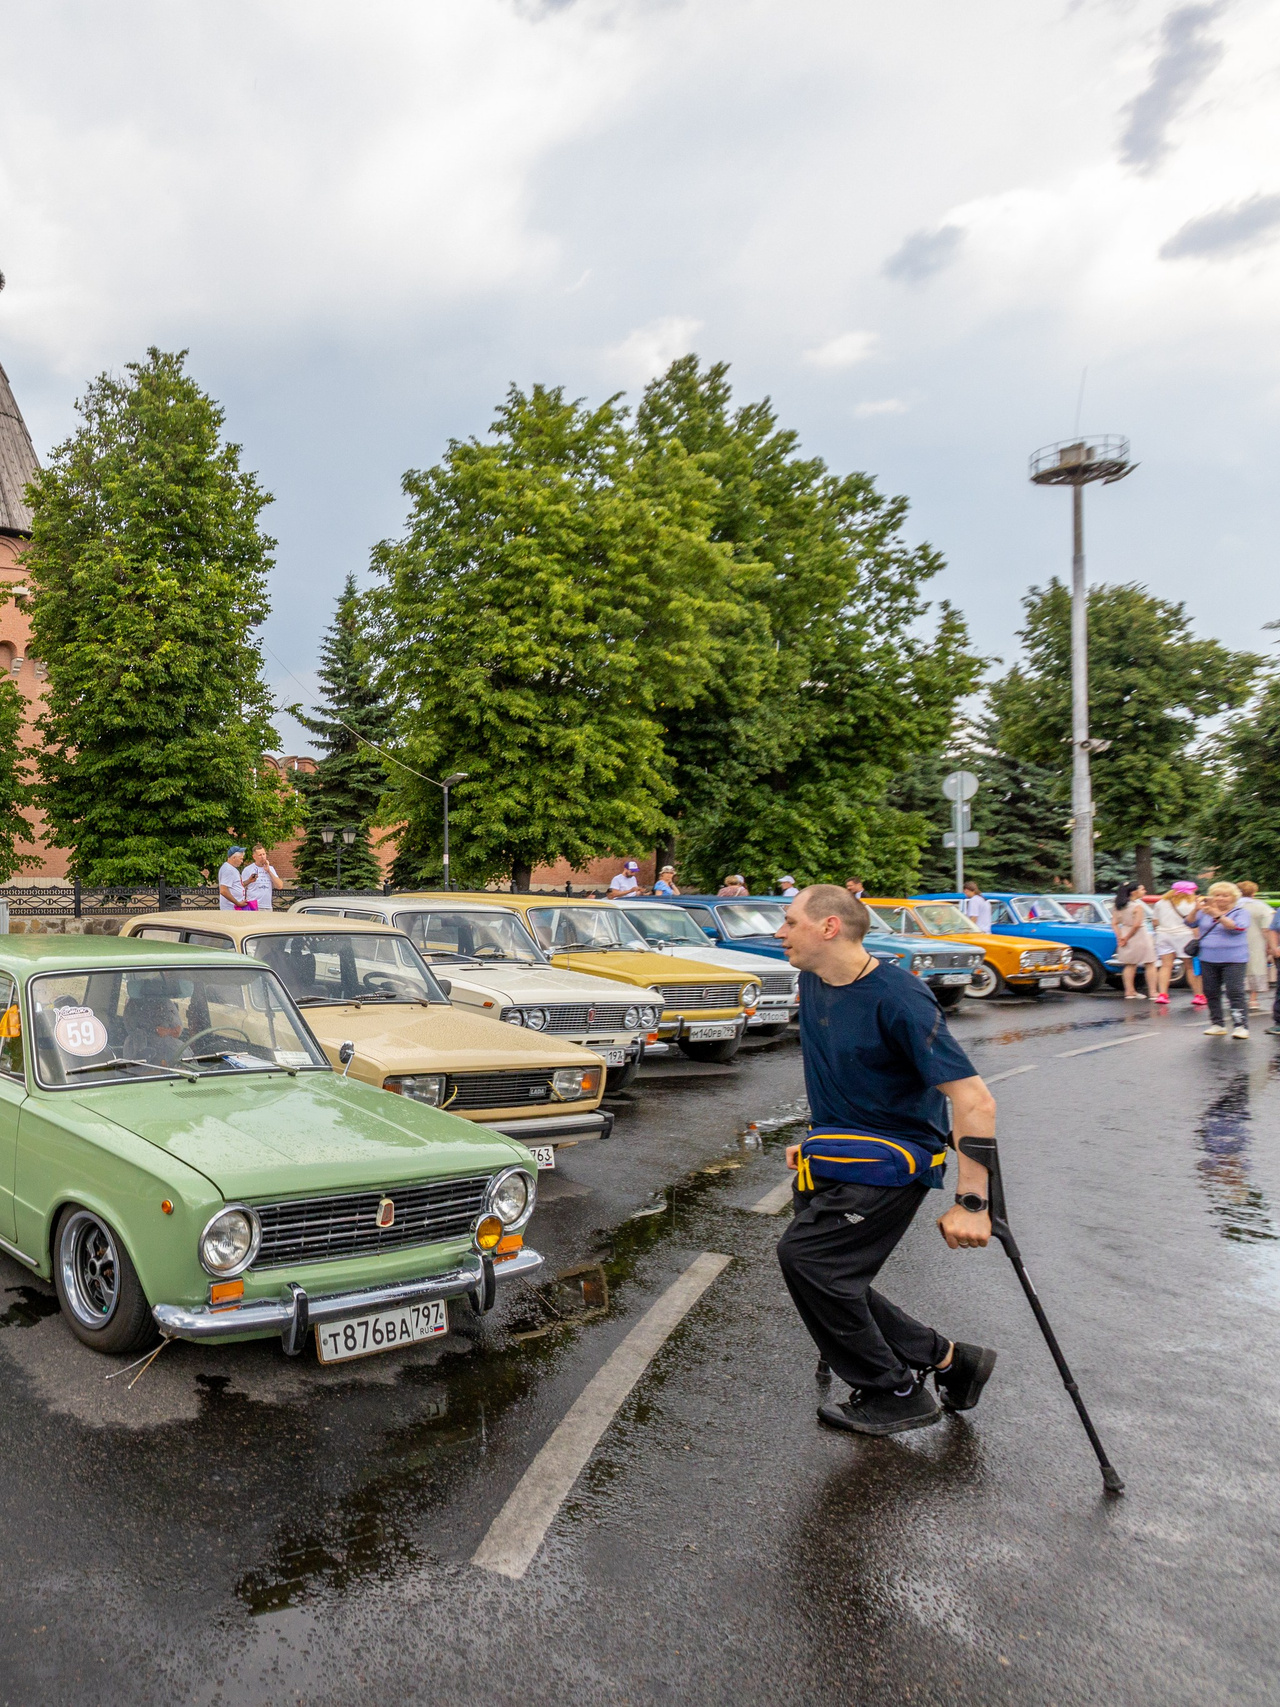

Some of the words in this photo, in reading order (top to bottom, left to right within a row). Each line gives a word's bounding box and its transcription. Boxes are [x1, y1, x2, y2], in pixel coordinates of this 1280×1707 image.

[66, 1021, 95, 1047] 59
[328, 1317, 411, 1355] Т876ВА
[411, 1302, 440, 1329] 797
[419, 1325, 434, 1335] RUS
